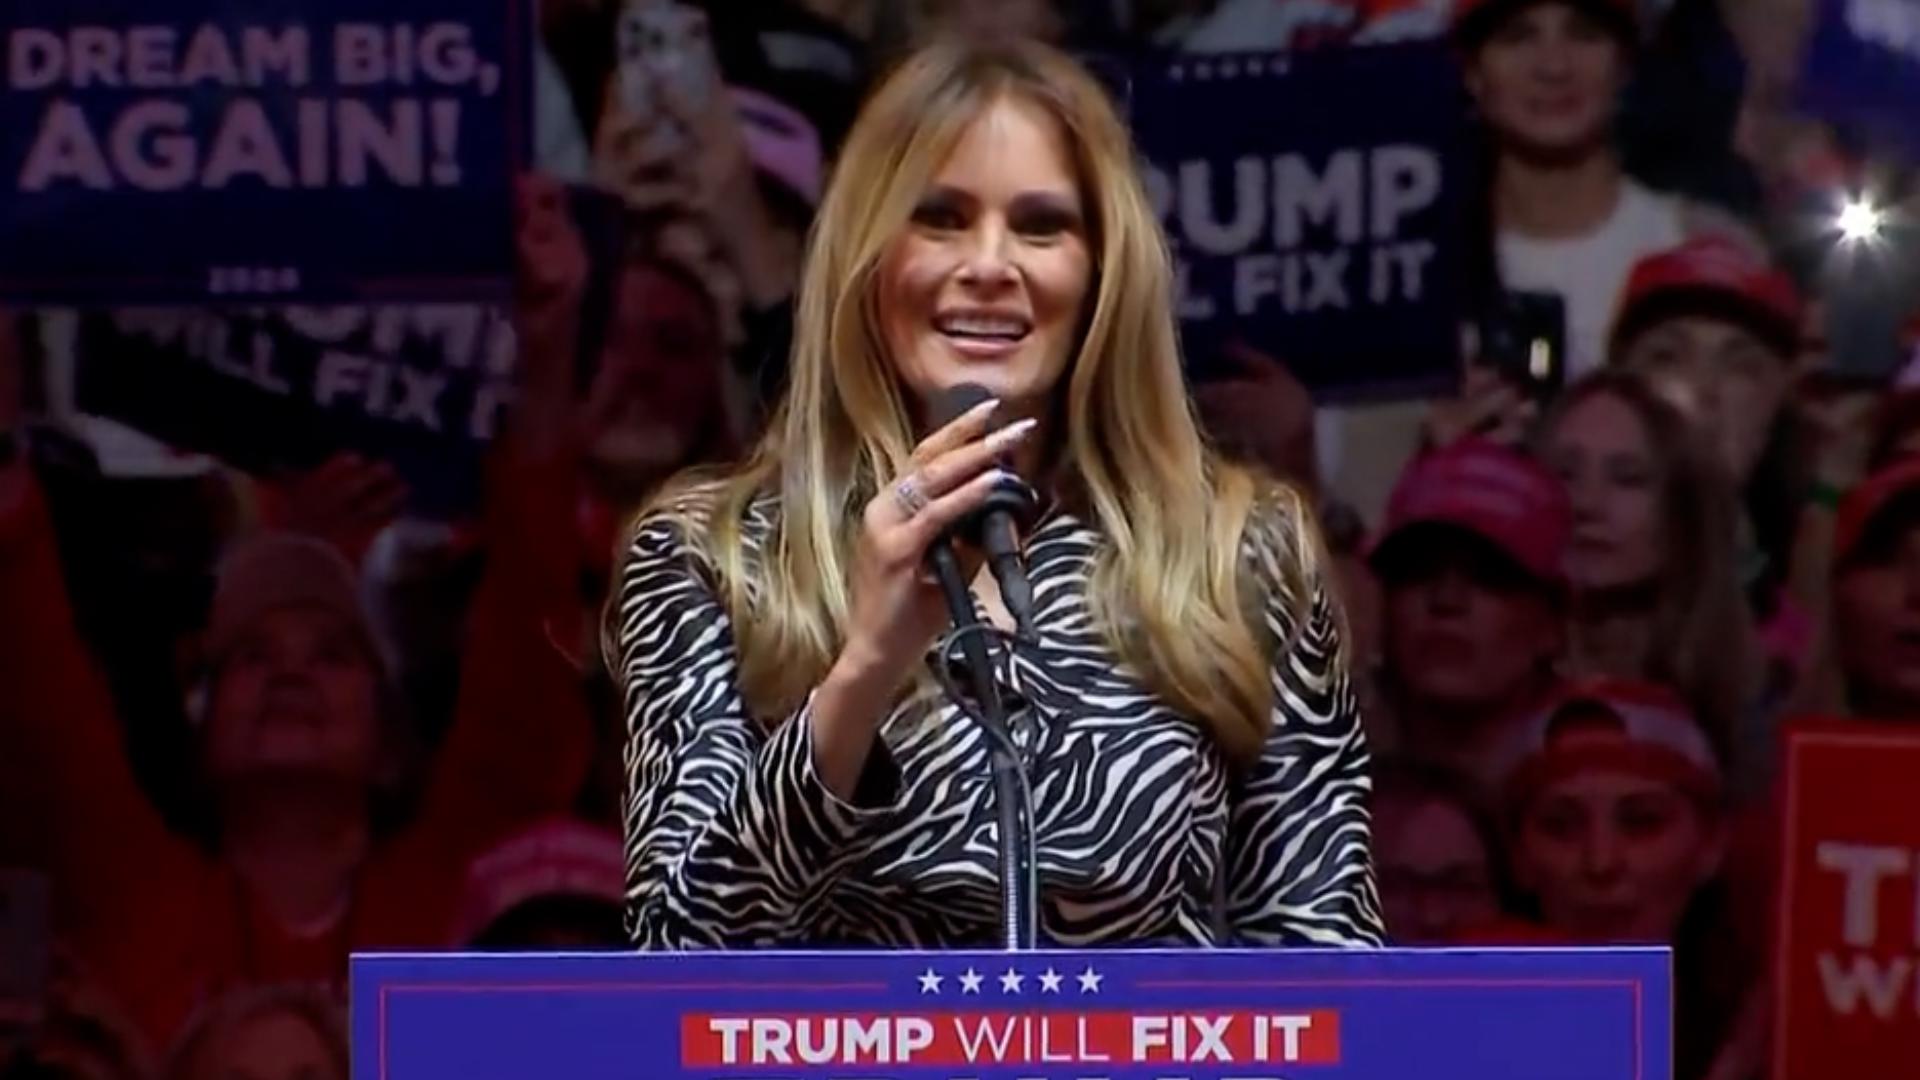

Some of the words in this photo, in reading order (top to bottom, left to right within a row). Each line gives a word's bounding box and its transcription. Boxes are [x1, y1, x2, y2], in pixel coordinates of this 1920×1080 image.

[9, 25, 310, 90] DREAM
[333, 23, 499, 96] BIG,
[18, 99, 462, 191] AGAIN!
[1146, 144, 1442, 256] UMP
[1232, 251, 1351, 316] FIX
[1367, 238, 1438, 307] IT
[314, 349, 446, 433] FIX
[1814, 840, 1920, 948] T
[1814, 949, 1920, 1022] W
[710, 1017, 933, 1063] TRUMP
[953, 1016, 1110, 1062] WILL
[1132, 1015, 1234, 1061] FIX
[1253, 1015, 1311, 1061] IT
